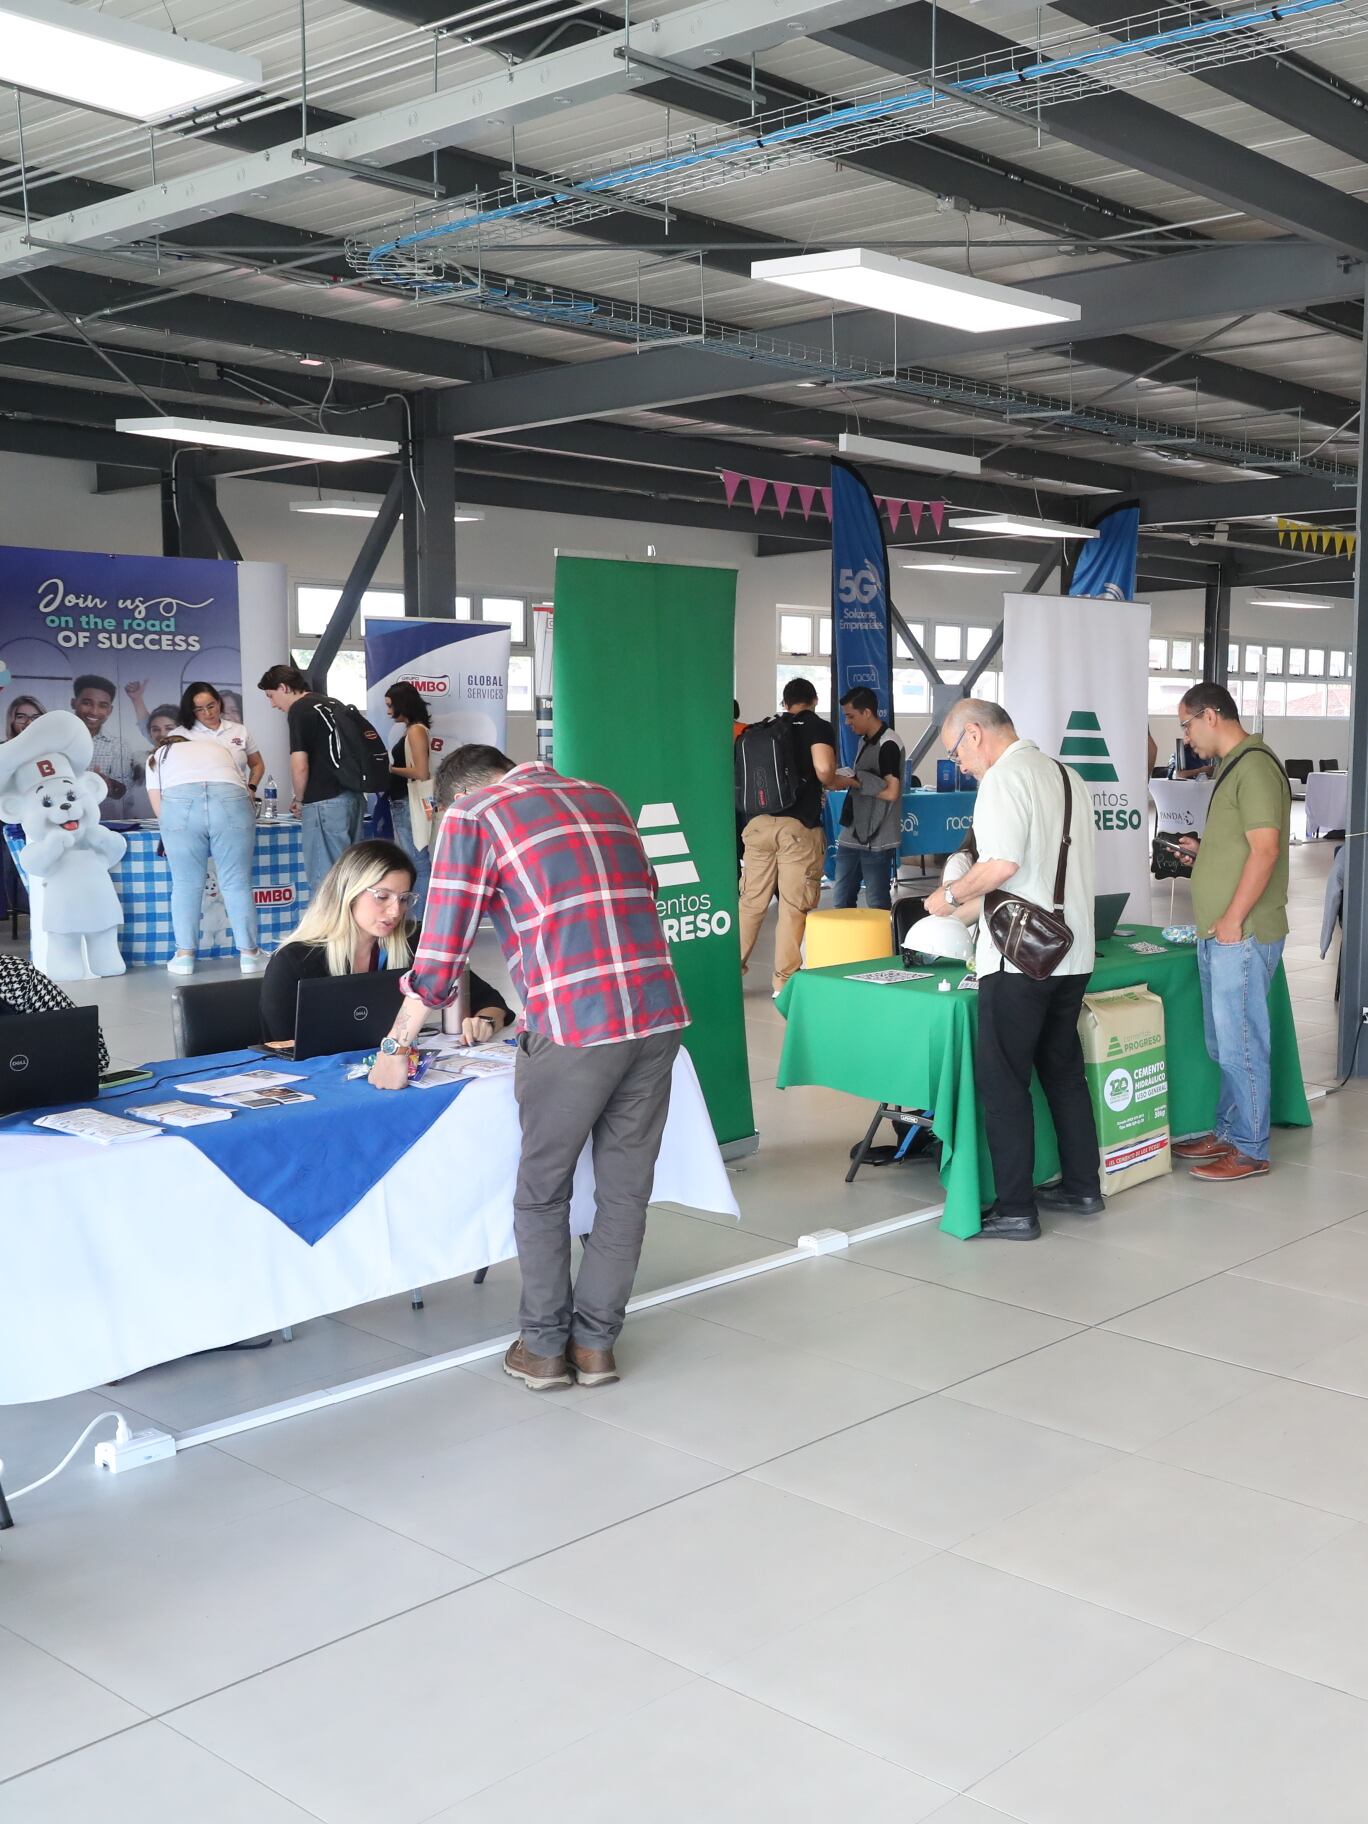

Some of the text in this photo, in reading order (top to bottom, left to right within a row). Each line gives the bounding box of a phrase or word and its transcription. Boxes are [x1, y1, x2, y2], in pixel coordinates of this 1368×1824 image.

[37, 578, 107, 613] Join
[839, 569, 878, 604] 5G
[45, 614, 176, 632] on the road
[57, 631, 201, 651] OF SUCCESS
[467, 675, 503, 687] GLOBAL
[467, 687, 504, 700] SERVICES
[1092, 790, 1129, 807] ntos
[1094, 809, 1142, 831] RESO
[254, 887, 293, 903] IMBO
[656, 893, 711, 916] entos
[663, 910, 731, 943] RESO
[1124, 1034, 1161, 1053] PROGRESO
[1133, 1060, 1165, 1080] CEMENTO
[1136, 1091, 1147, 1100] USO
